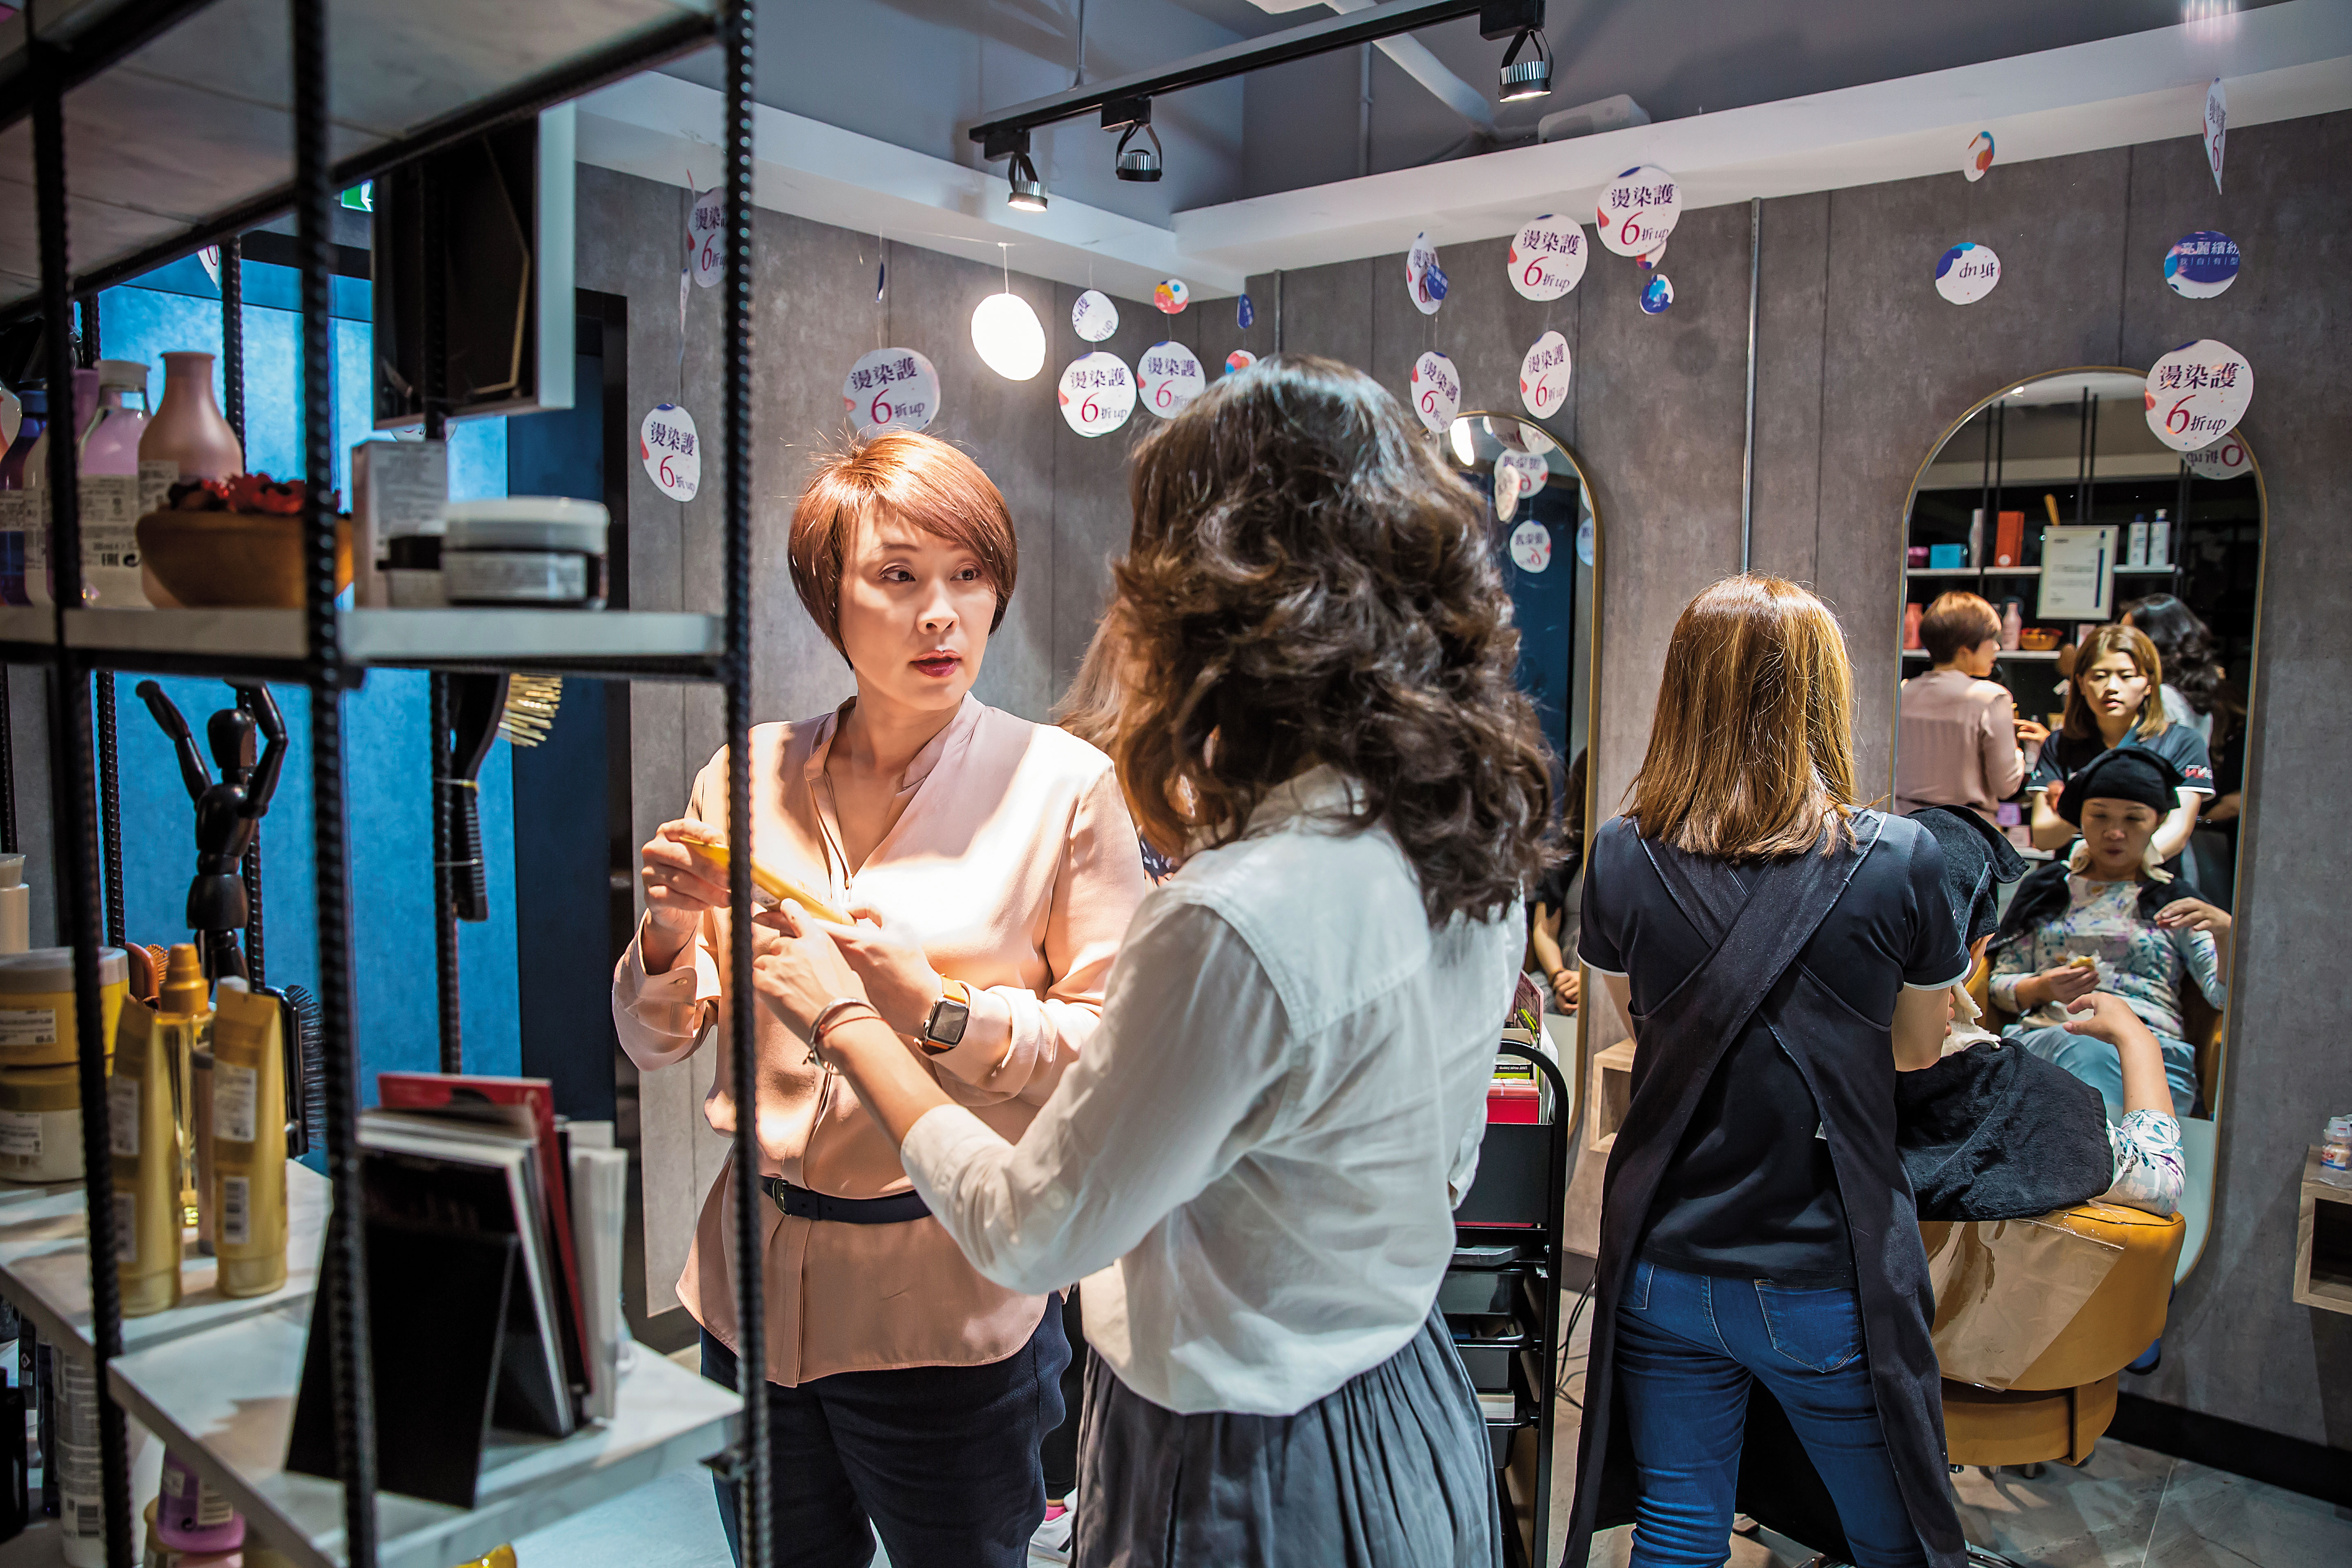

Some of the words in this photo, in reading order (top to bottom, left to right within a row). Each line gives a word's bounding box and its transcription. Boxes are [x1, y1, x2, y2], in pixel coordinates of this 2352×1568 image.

[1611, 184, 1674, 209] 燙染護
[1522, 229, 1580, 255] 燙染護
[1148, 356, 1196, 377] 燙染護
[1528, 343, 1564, 375] 燙染護
[851, 356, 918, 393] 燙染護
[1070, 367, 1126, 389] 燙染護
[1423, 359, 1458, 404] 燙染護
[2158, 363, 2240, 391] 燙染護
[650, 421, 695, 456] 燙染護
